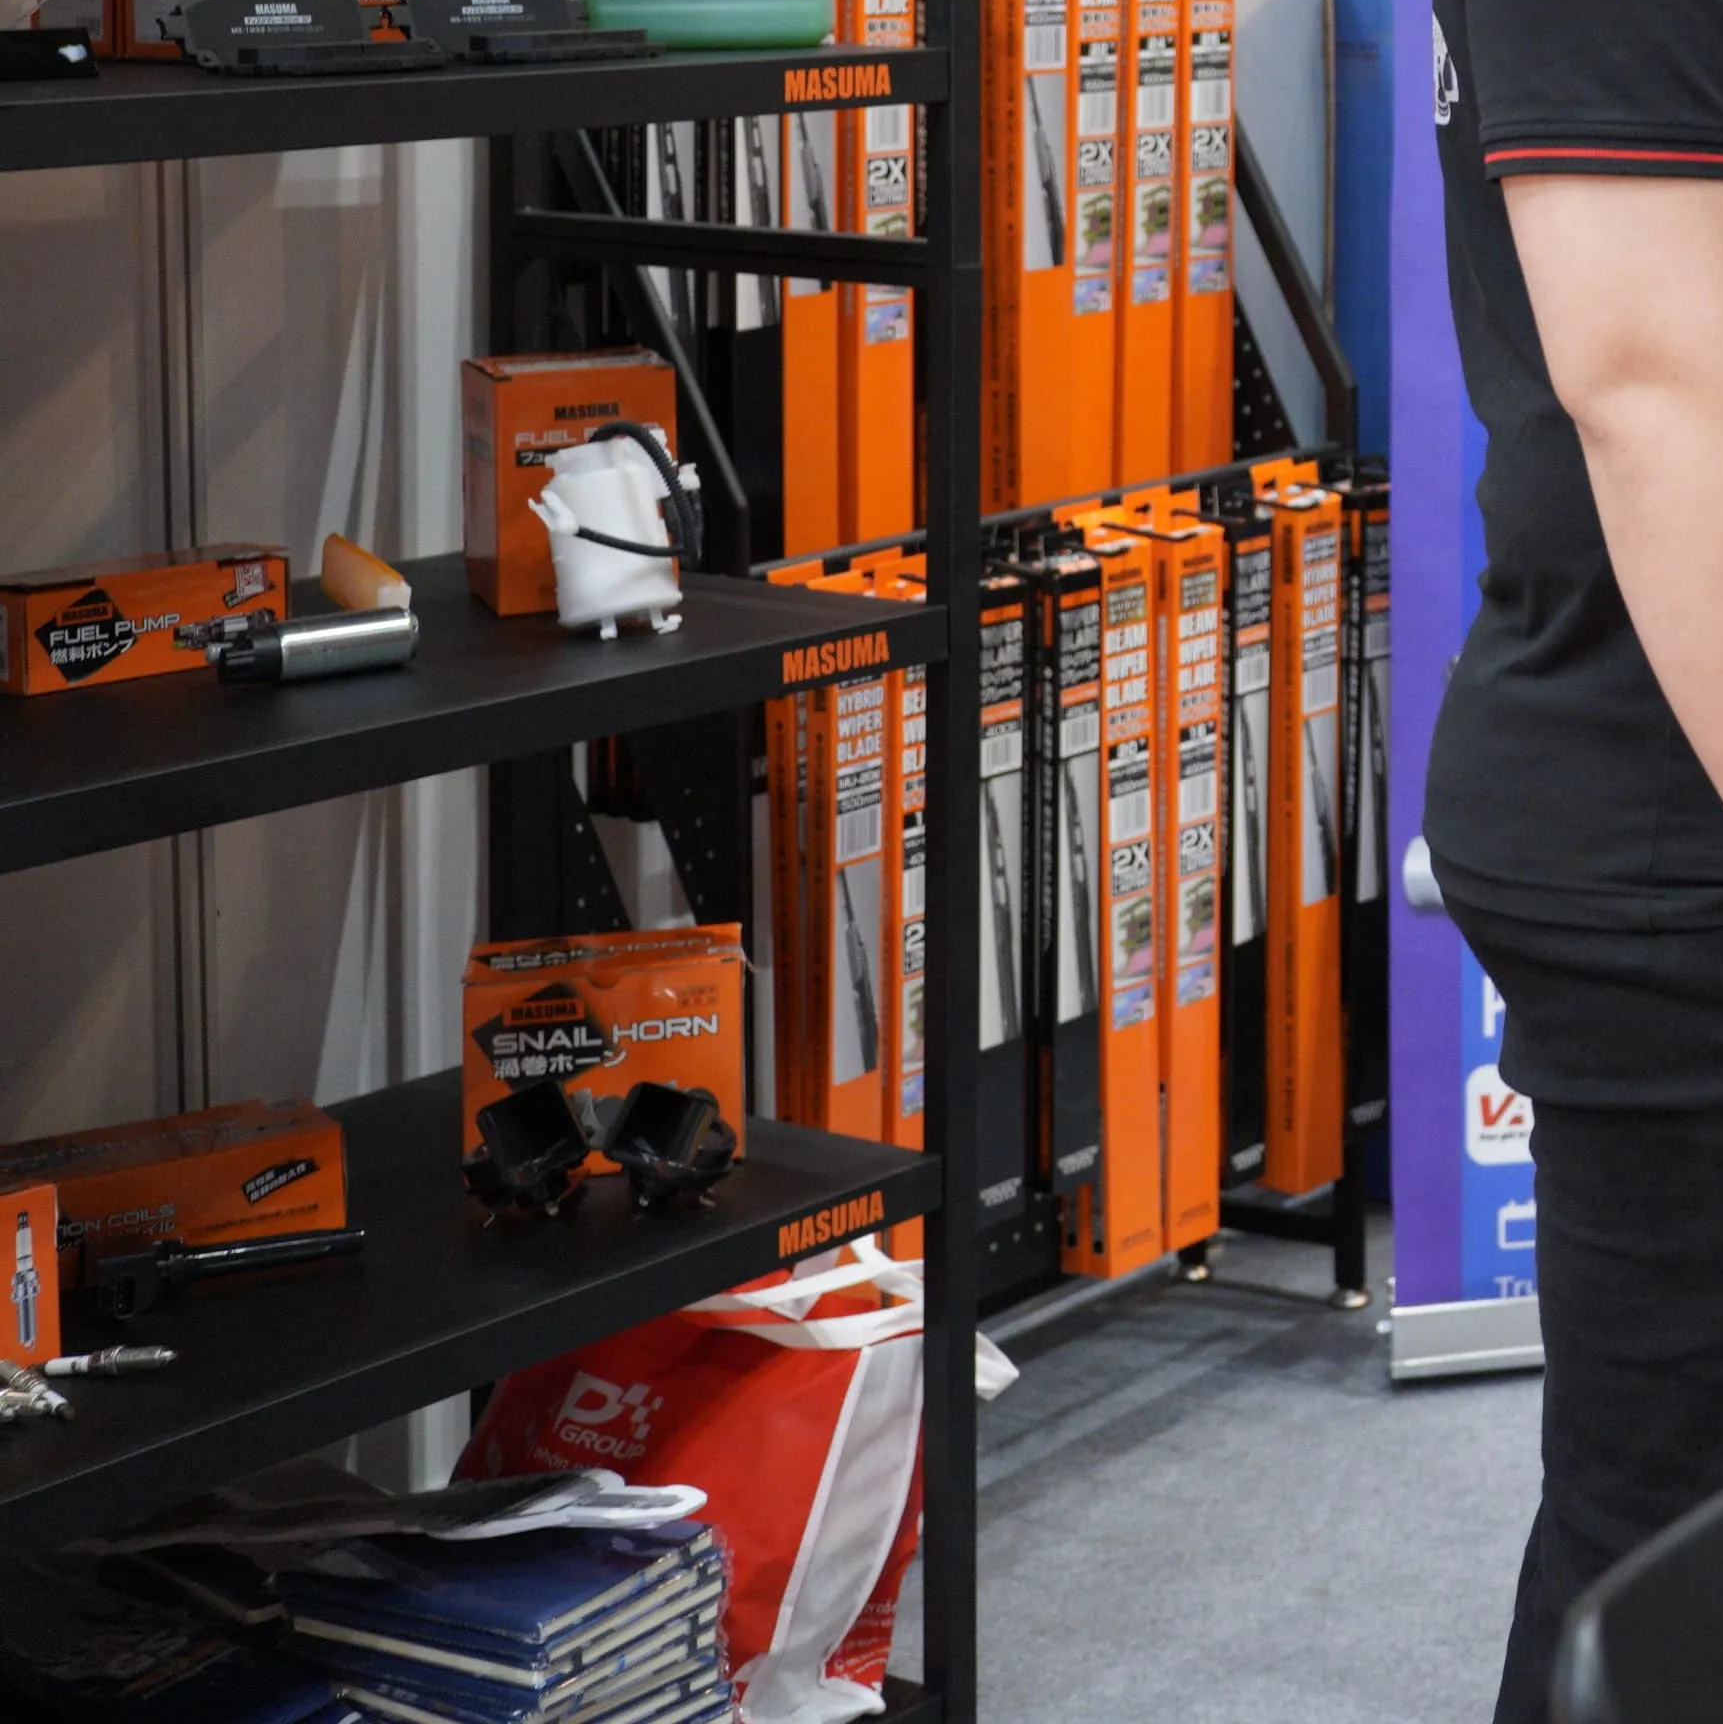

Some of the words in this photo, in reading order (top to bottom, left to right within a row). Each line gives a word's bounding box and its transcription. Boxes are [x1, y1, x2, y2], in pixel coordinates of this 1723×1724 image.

[254, 2, 298, 16] MASUMA
[784, 63, 892, 103] MASUMA
[1138, 134, 1172, 159] 2X
[1192, 127, 1228, 152] 2X
[1080, 142, 1114, 168] 2X
[868, 158, 907, 186] 2X
[554, 402, 621, 421] MASUMA
[515, 430, 577, 447] FUEL
[61, 606, 109, 621] MASUMA
[50, 626, 110, 646] FUEL
[115, 613, 181, 638] PUMP
[782, 631, 891, 683] MASUMA
[837, 685, 884, 716] HYBRID
[837, 709, 883, 738] WIPER
[837, 733, 883, 763] BLADE
[1181, 825, 1214, 851] 2X
[1113, 846, 1149, 874] 2X
[510, 1002, 578, 1022] MASUMA
[492, 1026, 603, 1055] SNAIL
[612, 1014, 719, 1045] HORN
[778, 1192, 885, 1258] MASUMA
[559, 1424, 647, 1460] GROUP
